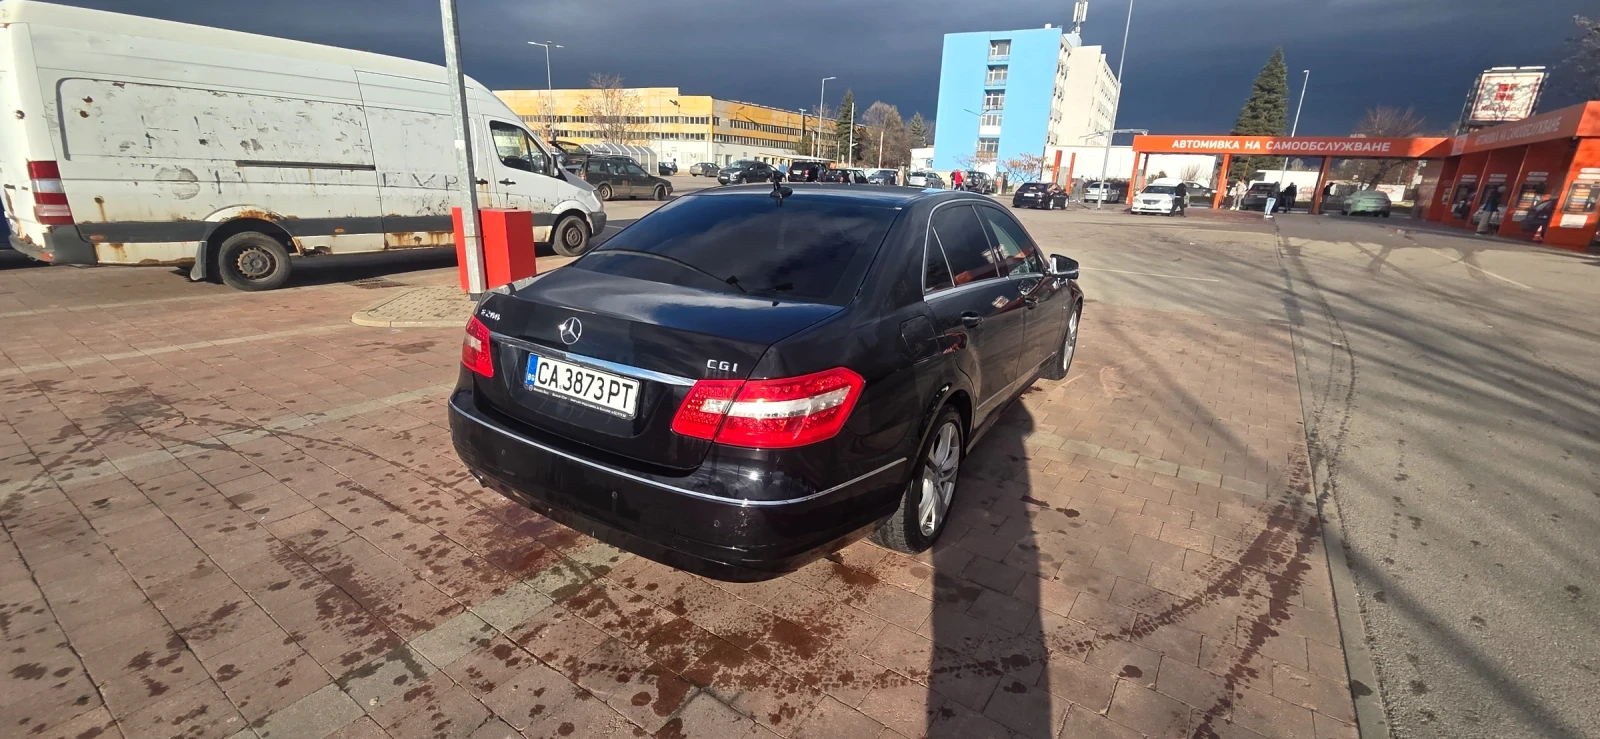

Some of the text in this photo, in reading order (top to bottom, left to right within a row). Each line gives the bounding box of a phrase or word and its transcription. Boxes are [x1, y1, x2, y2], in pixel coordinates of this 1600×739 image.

[1171, 139, 1391, 152] АВТОМИВКА НА САМООБСЛУЖВАНЕ
[706, 359, 739, 373] CGI
